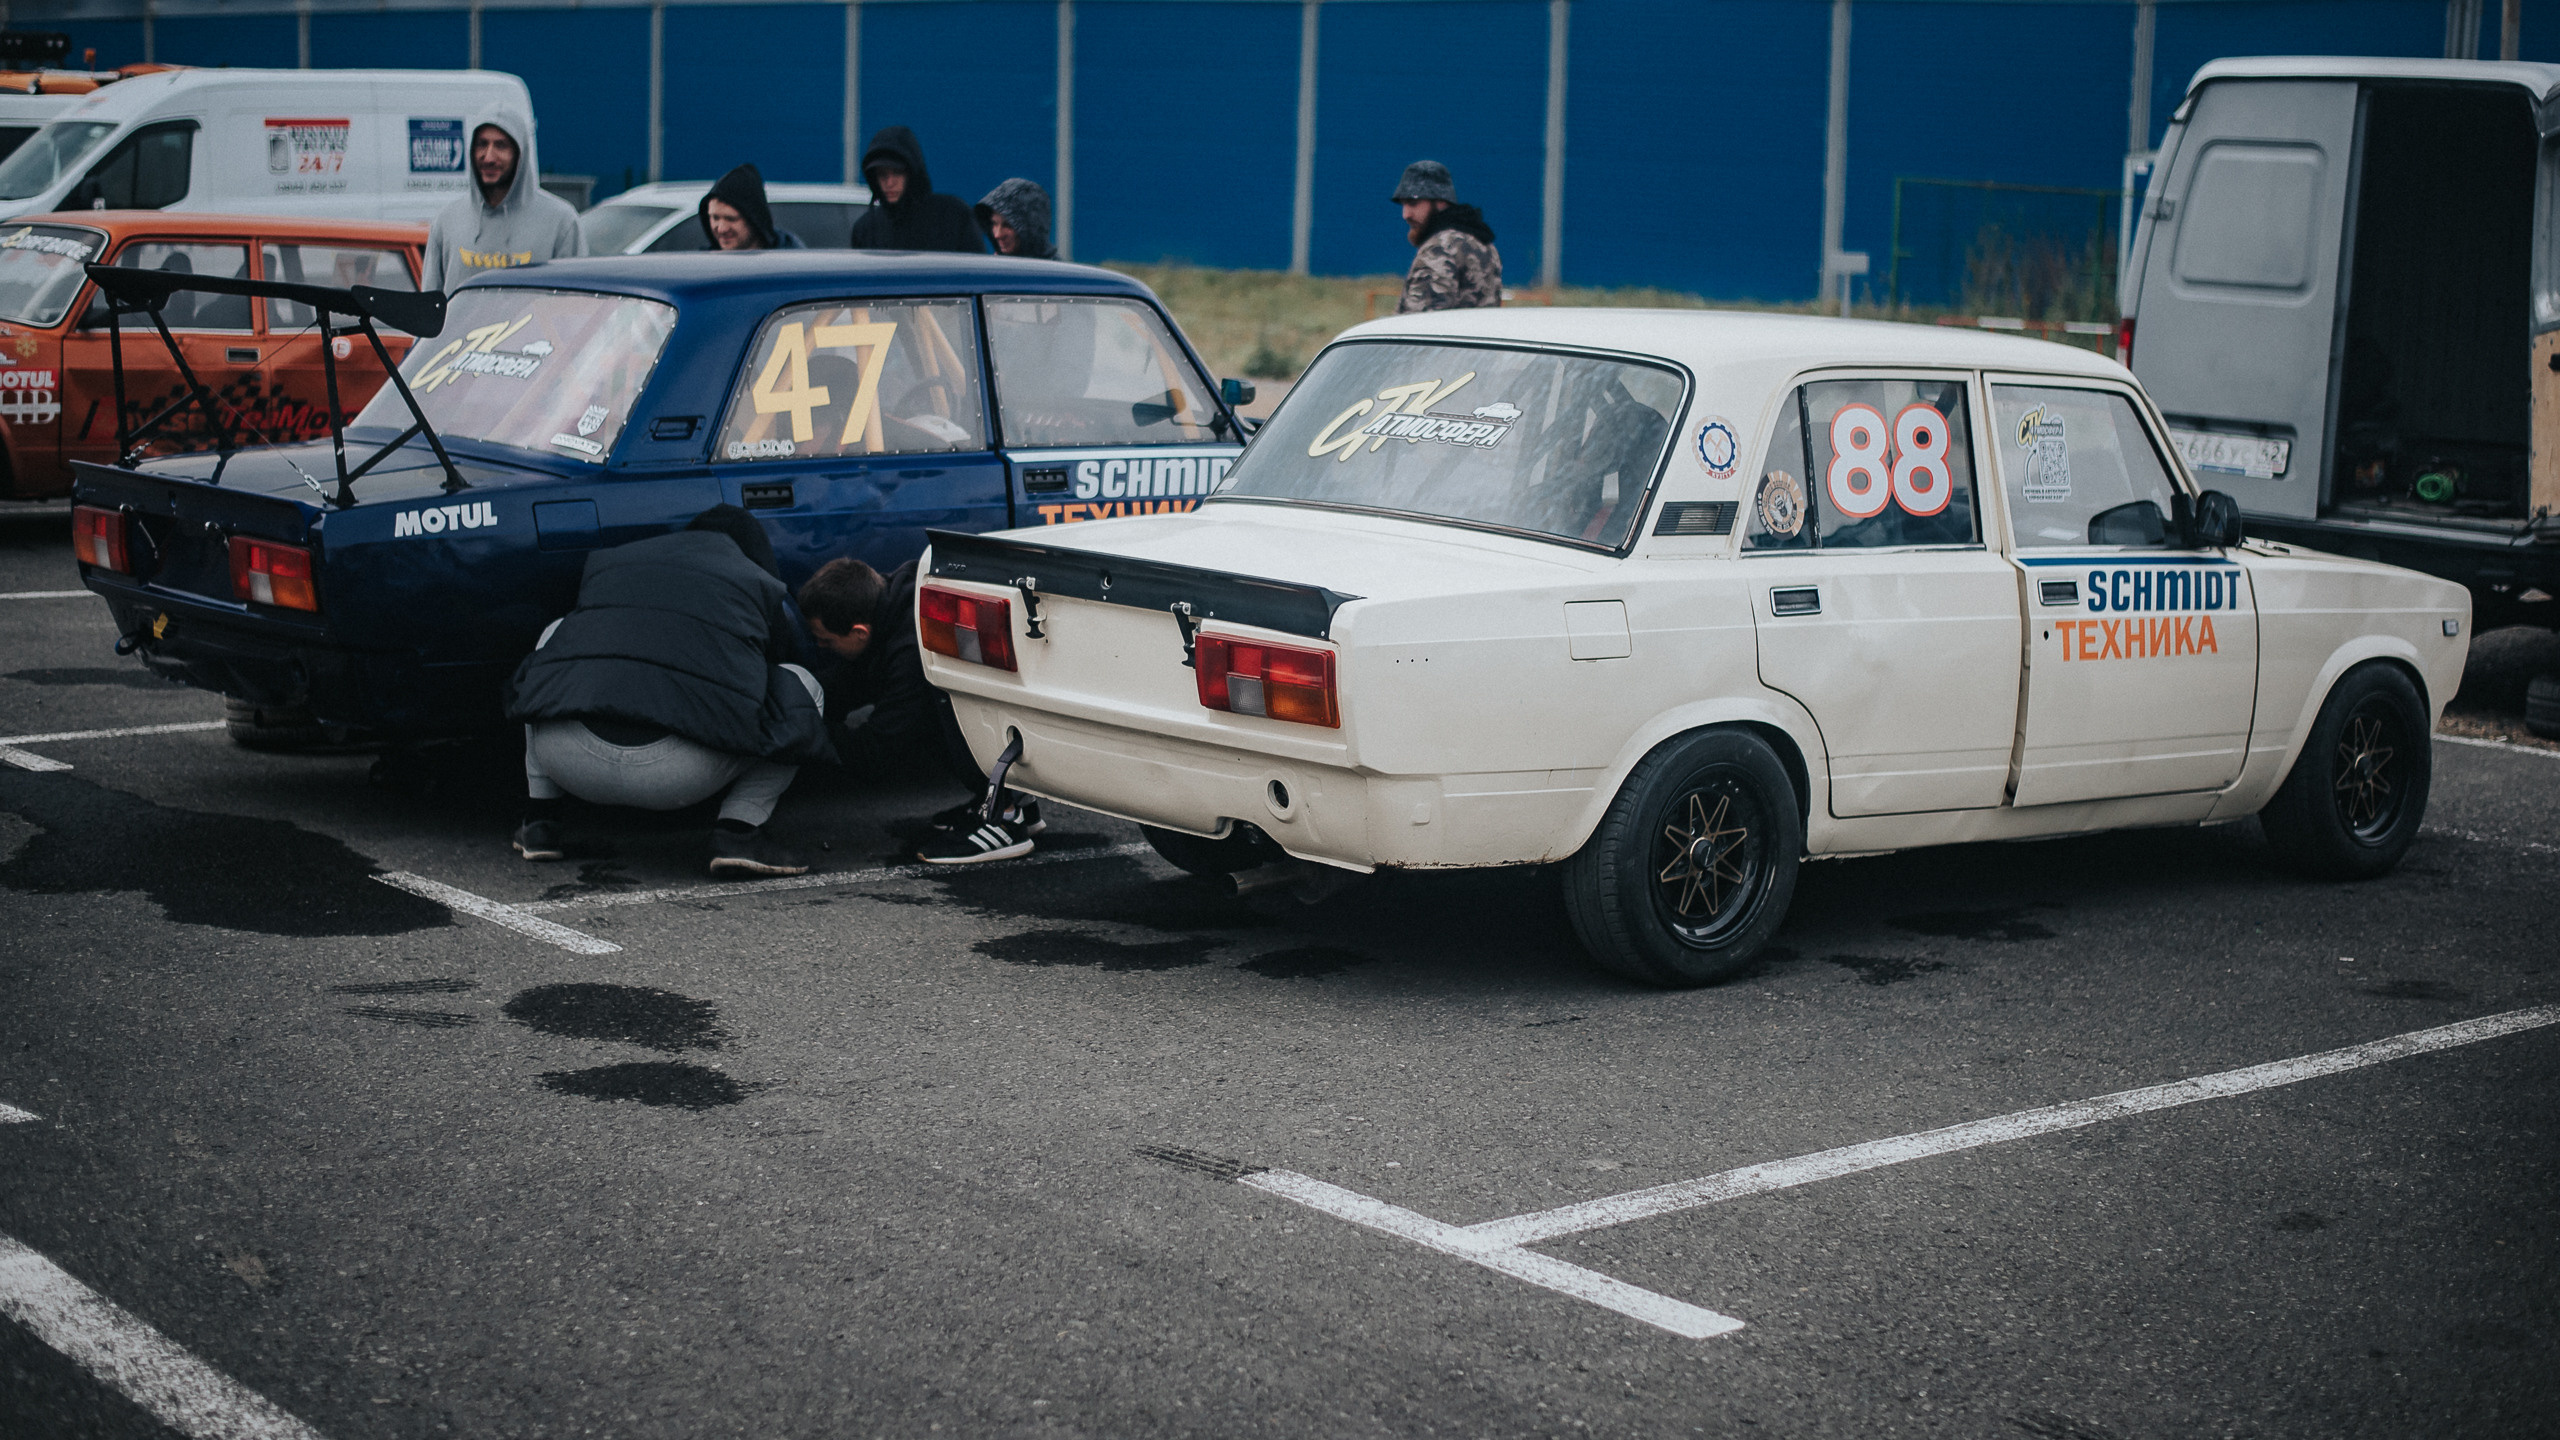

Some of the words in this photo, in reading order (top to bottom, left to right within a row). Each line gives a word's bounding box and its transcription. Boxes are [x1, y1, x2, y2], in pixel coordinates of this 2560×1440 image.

[0, 370, 55, 388] OTUL
[752, 322, 898, 445] 47
[1364, 414, 1509, 447] АТМОСФЕРА
[1074, 458, 1237, 500] SCHMID
[1827, 403, 1953, 518] 88
[394, 501, 498, 538] MOTUL
[2055, 615, 2218, 663] ТЕХНИКА
